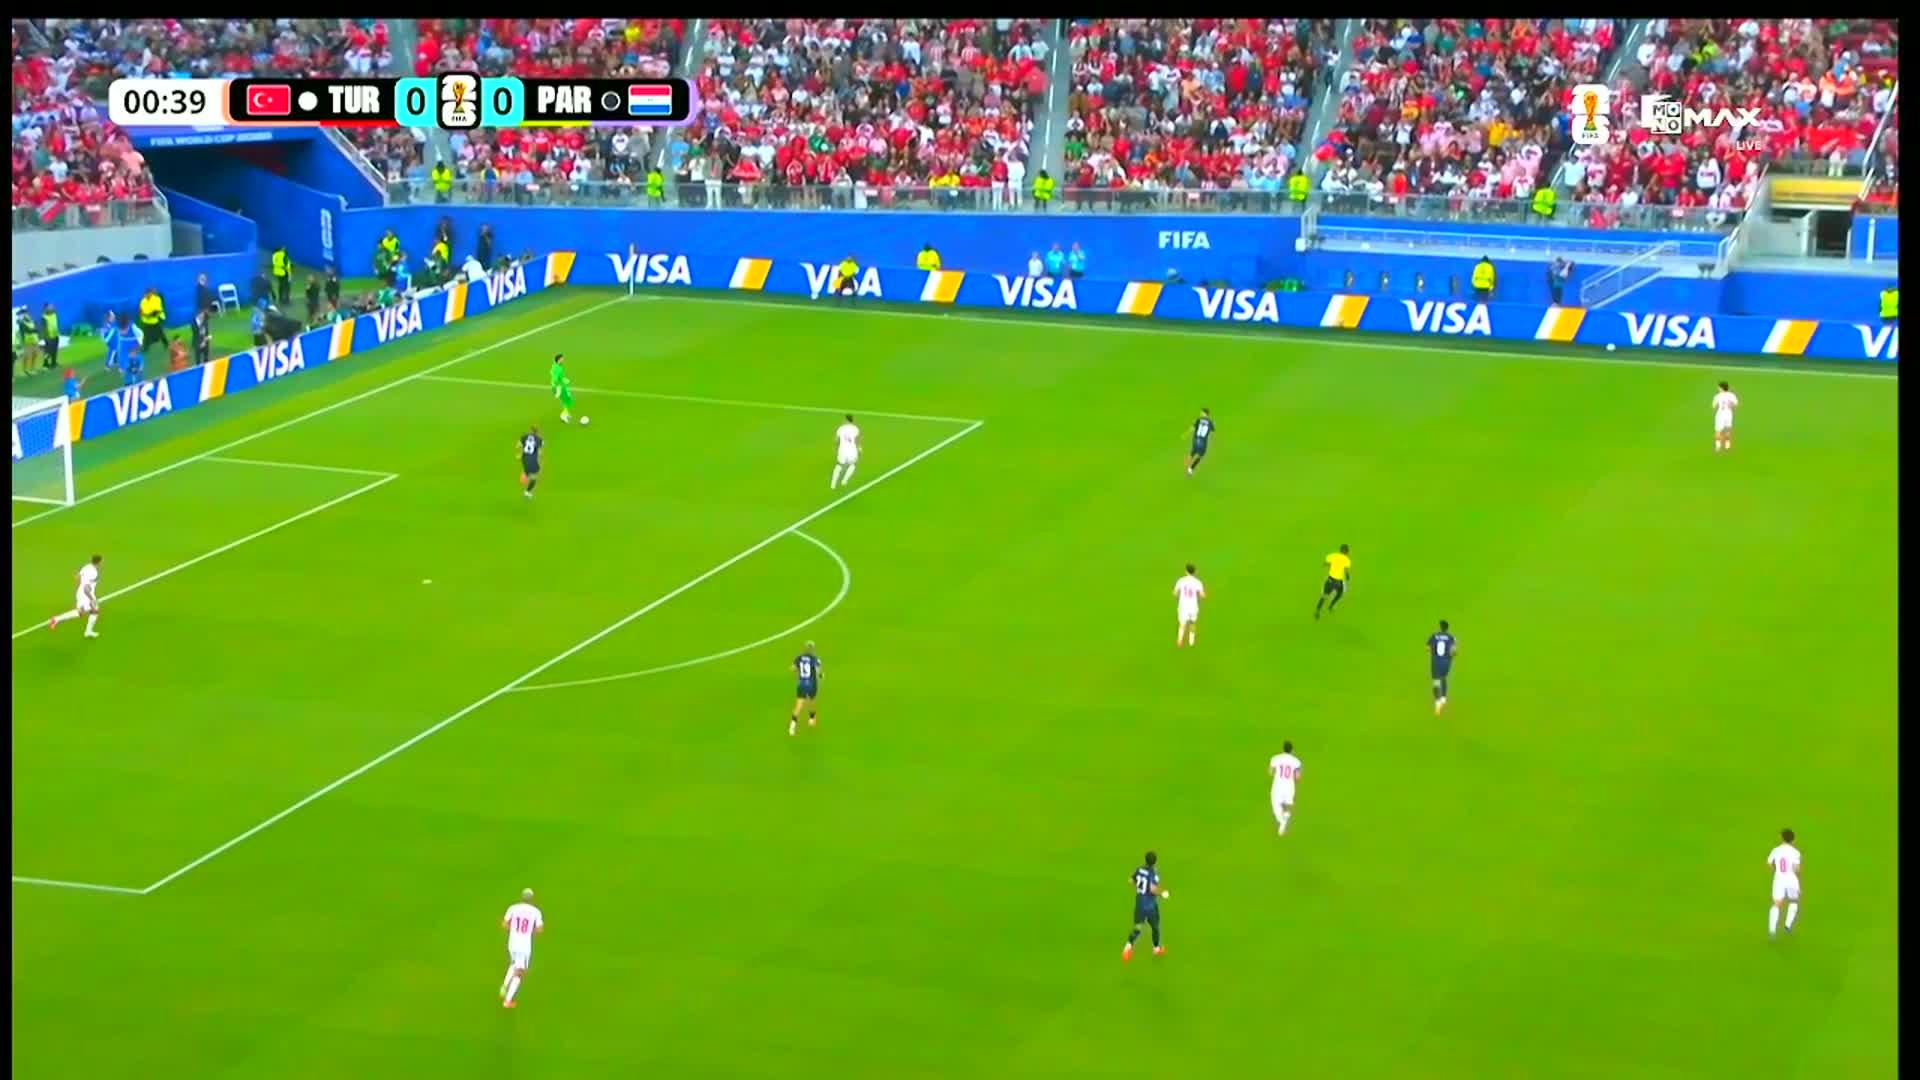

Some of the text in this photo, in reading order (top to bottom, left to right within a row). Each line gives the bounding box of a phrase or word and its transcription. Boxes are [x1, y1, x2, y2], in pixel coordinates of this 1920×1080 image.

[1159, 231, 1210, 249] FIFA
[484, 265, 527, 306] VISA
[606, 253, 692, 285] VISA
[992, 274, 1077, 309] VISA
[1193, 286, 1279, 322] VISA
[372, 300, 423, 342] VISA
[1402, 300, 1492, 335] VISA
[1619, 312, 1716, 349] VISA
[249, 337, 305, 382] VISA
[105, 378, 173, 427] VISA
[1279, 764, 1292, 779] 10
[516, 917, 529, 934] 18
